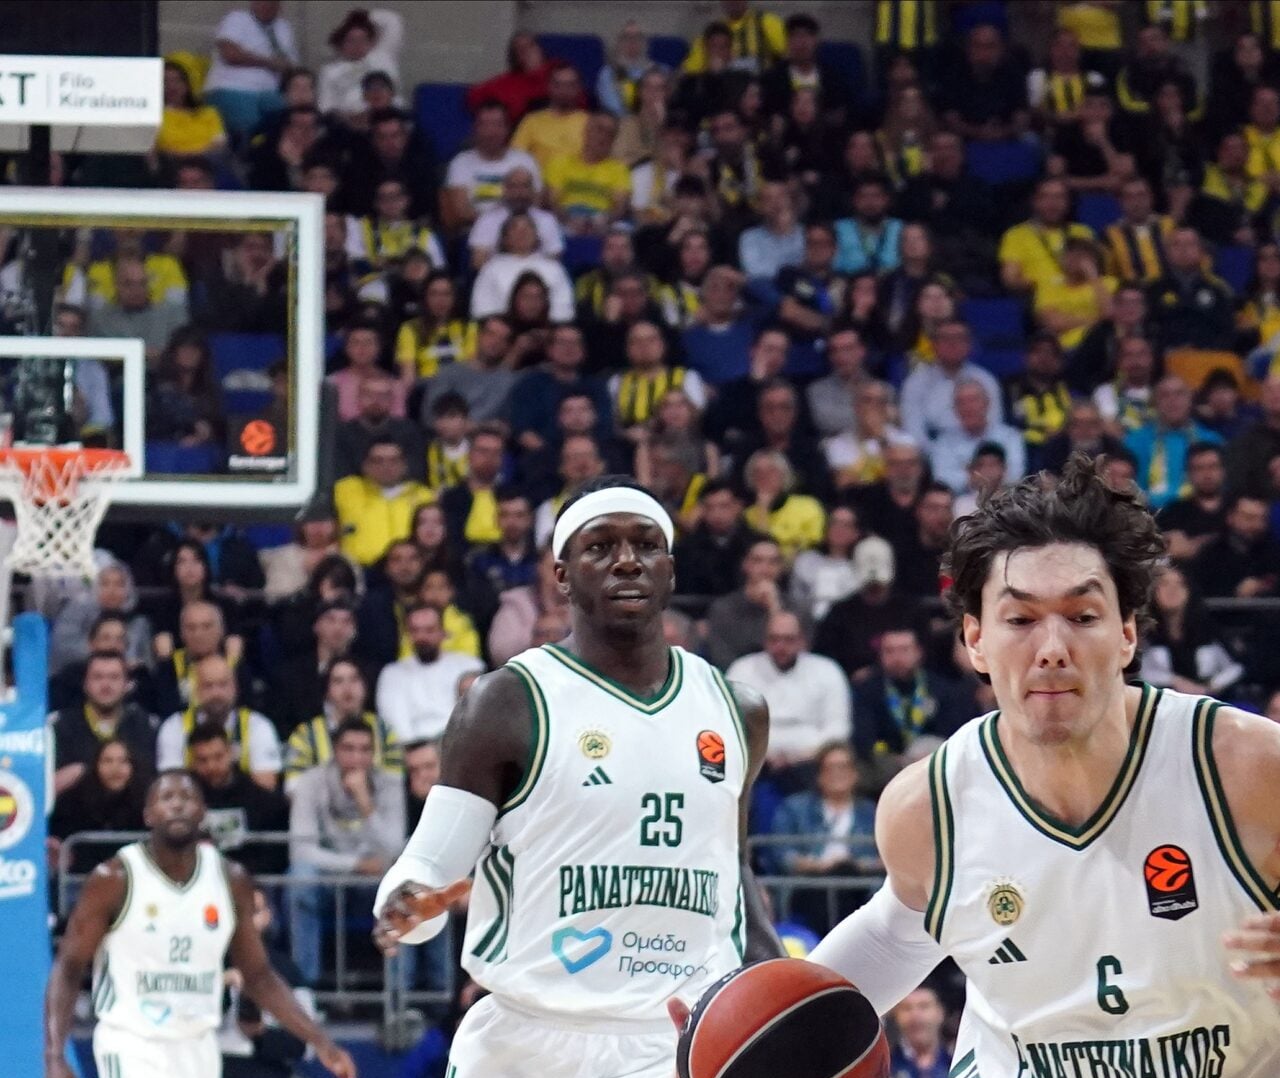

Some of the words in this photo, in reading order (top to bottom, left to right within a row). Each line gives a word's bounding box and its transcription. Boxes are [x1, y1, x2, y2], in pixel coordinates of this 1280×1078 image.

[59, 73, 94, 88] Filo
[59, 94, 148, 108] Kiralama
[640, 792, 685, 847] 25
[168, 936, 192, 963] 22
[622, 931, 687, 954] Ομάδα
[1097, 955, 1130, 1015] 6
